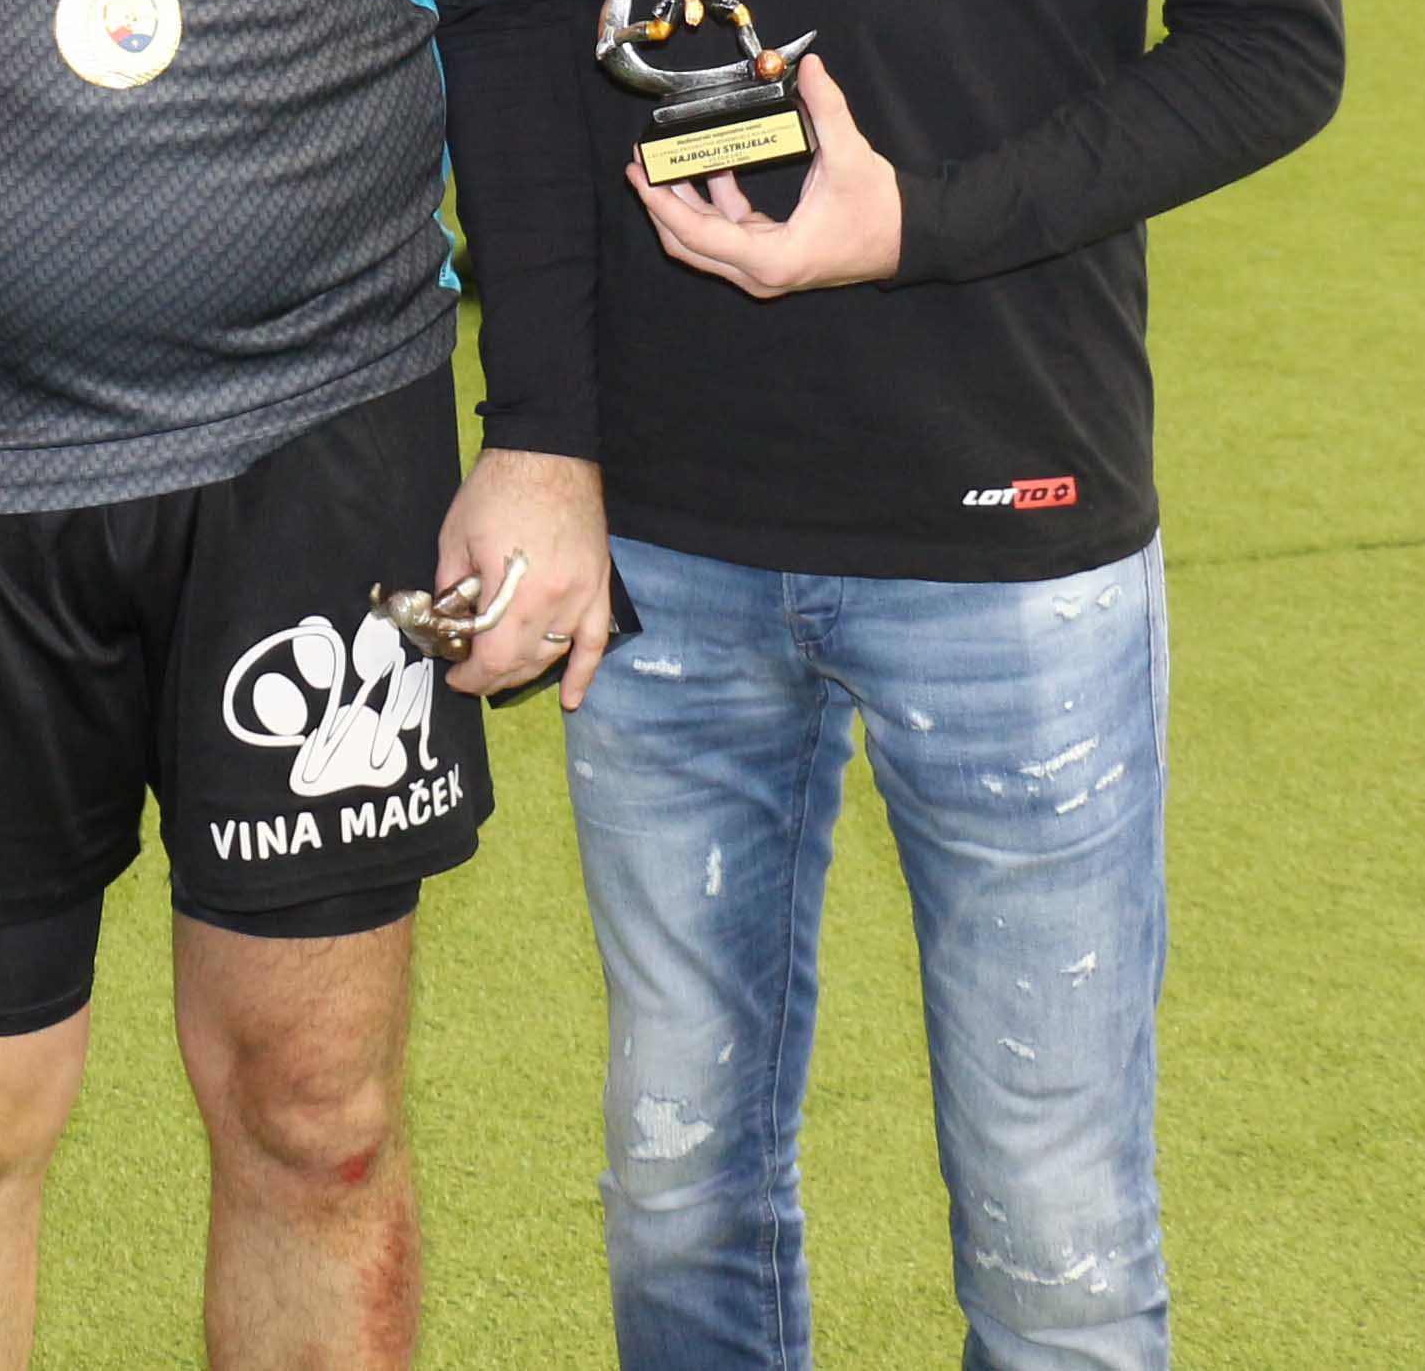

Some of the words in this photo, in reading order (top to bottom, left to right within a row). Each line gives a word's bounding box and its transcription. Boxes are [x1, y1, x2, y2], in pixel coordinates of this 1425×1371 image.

[669, 148, 721, 166] NAJBOLJI
[723, 135, 778, 153] STRIJELAC
[962, 487, 1048, 506] LOTTO
[210, 811, 323, 861] VINA
[340, 763, 464, 843] MAČEK
